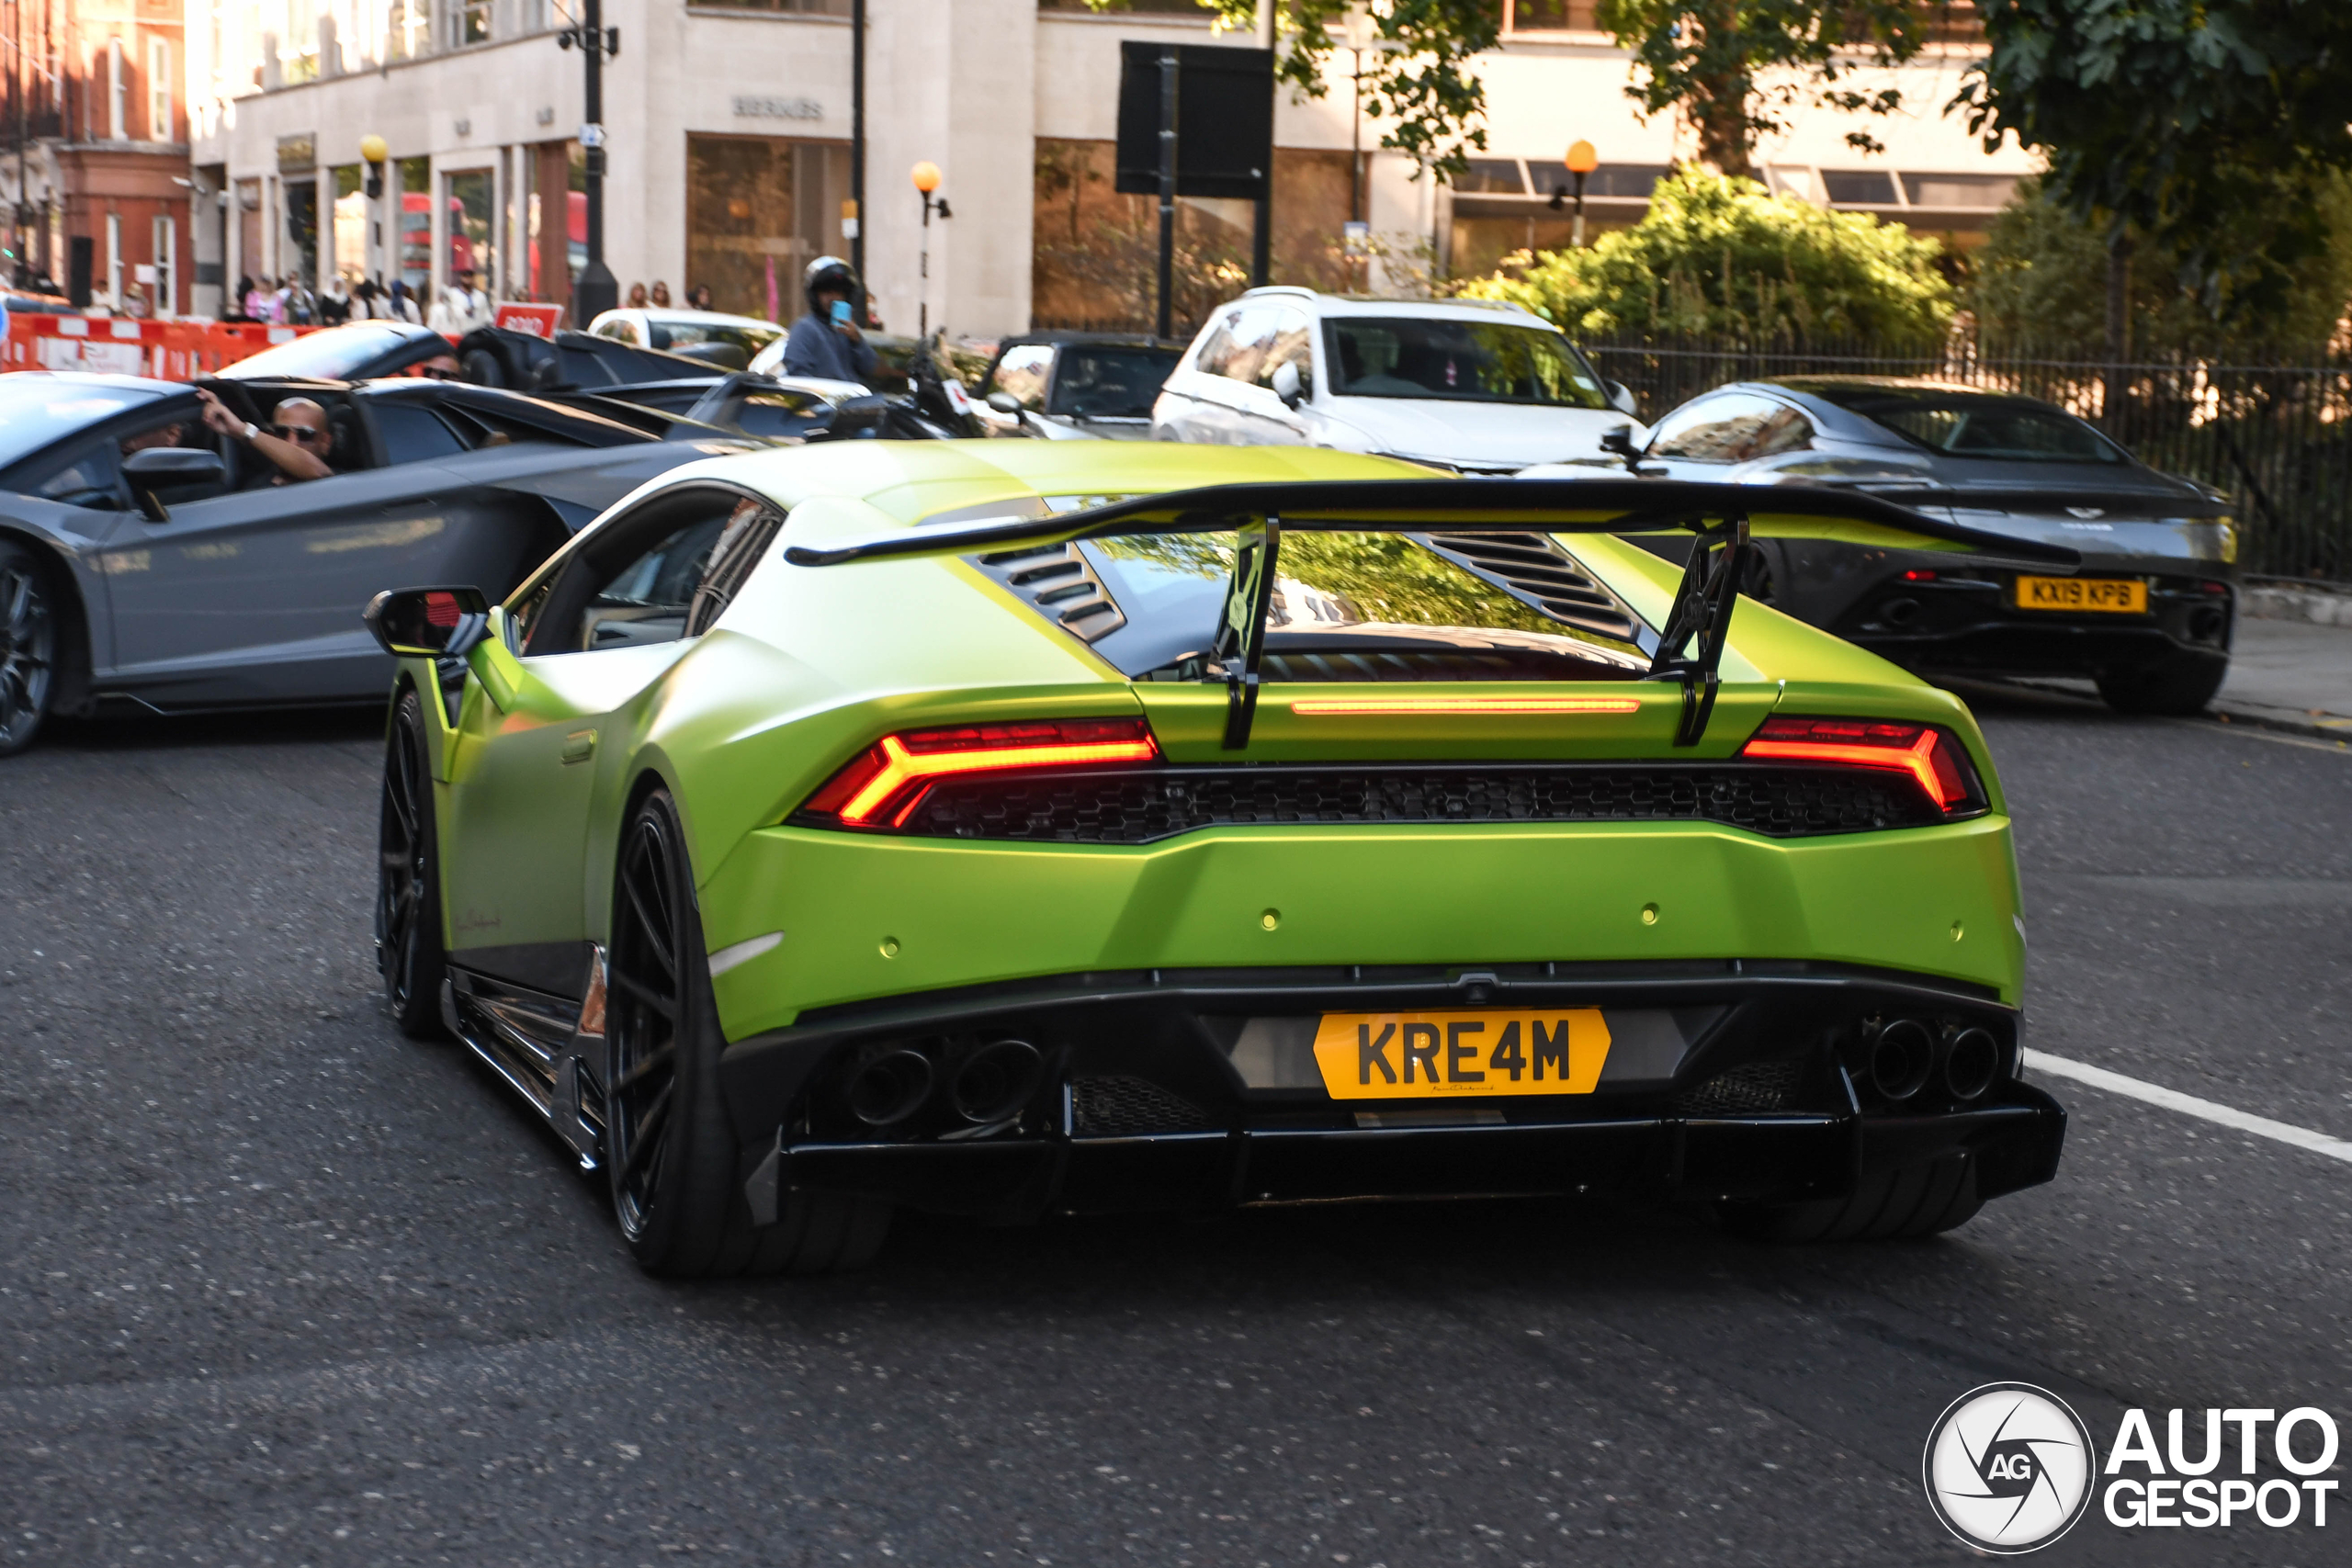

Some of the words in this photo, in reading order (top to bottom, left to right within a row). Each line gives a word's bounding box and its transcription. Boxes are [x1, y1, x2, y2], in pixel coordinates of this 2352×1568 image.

[2032, 580, 2082, 604] KX19
[2088, 581, 2132, 607] KPB
[1358, 1019, 1570, 1085] KRE4M
